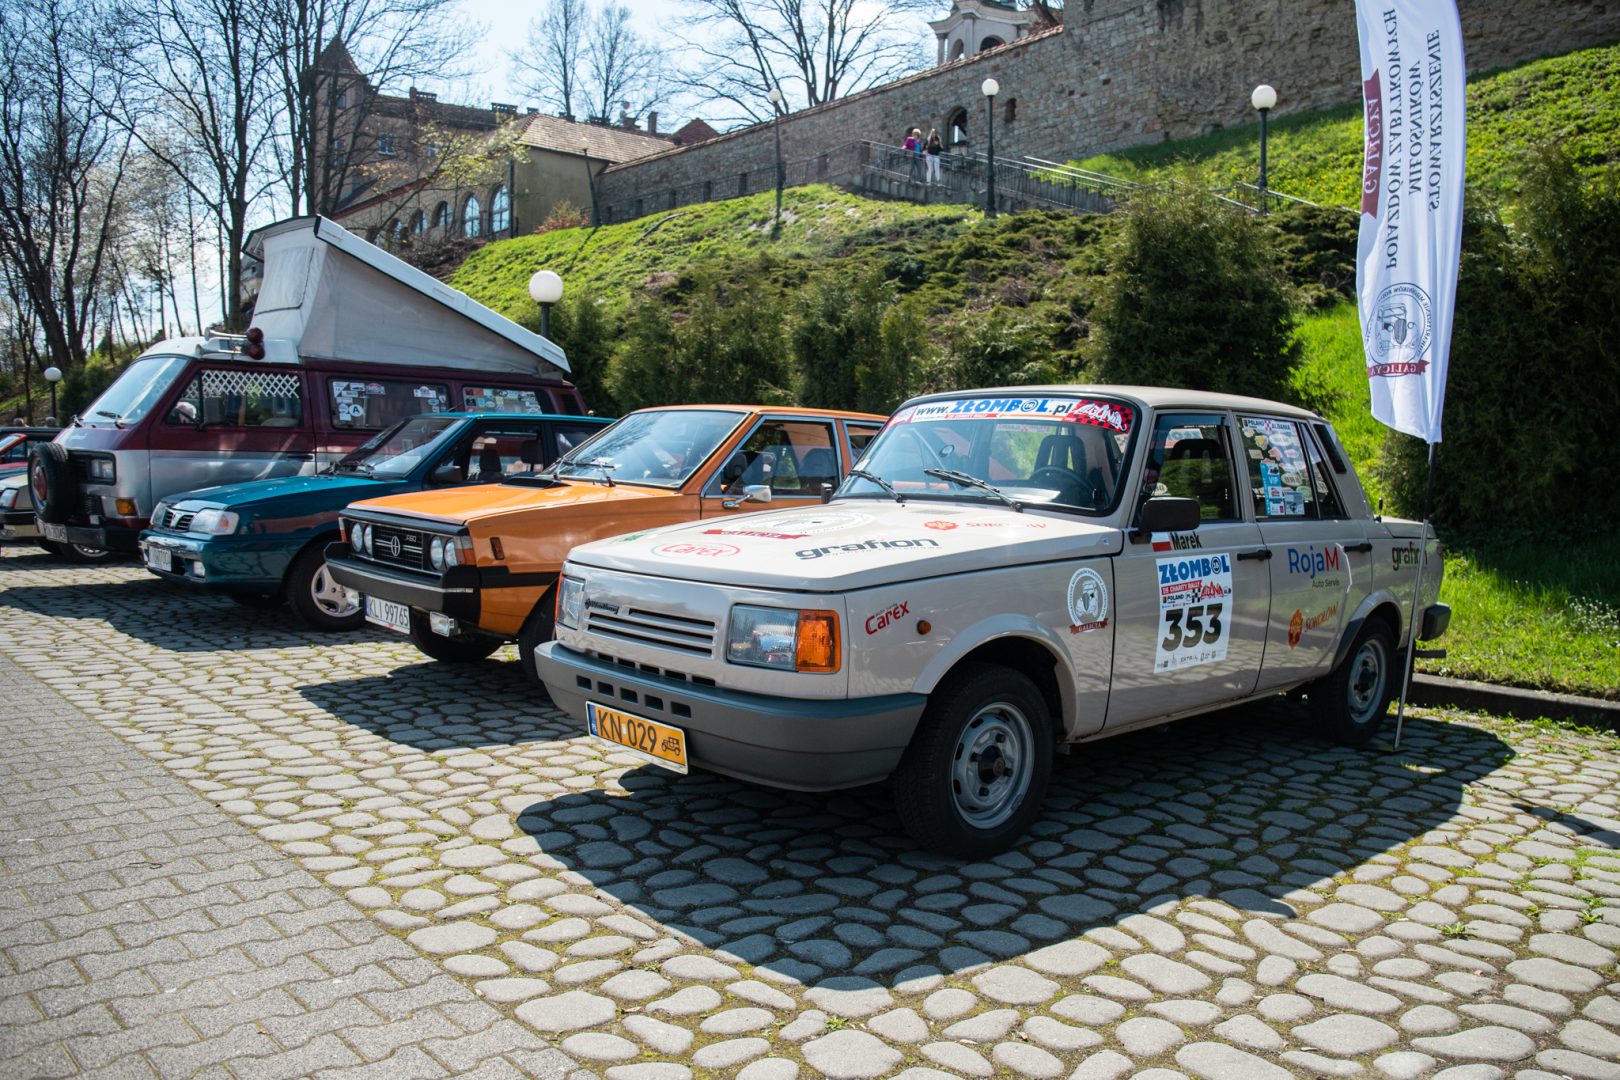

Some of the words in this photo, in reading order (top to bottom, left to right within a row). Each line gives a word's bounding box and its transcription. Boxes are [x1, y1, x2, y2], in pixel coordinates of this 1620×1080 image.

[795, 538, 940, 560] grafion
[1170, 531, 1202, 551] Marek
[1158, 555, 1230, 584] ZŁOMBOL
[1288, 545, 1340, 579] RojaM
[368, 598, 382, 618] KLI
[385, 604, 409, 627] 99765
[865, 600, 910, 635] Carex
[1162, 603, 1223, 652] 353
[598, 709, 622, 743] KN
[627, 719, 657, 753] 029
